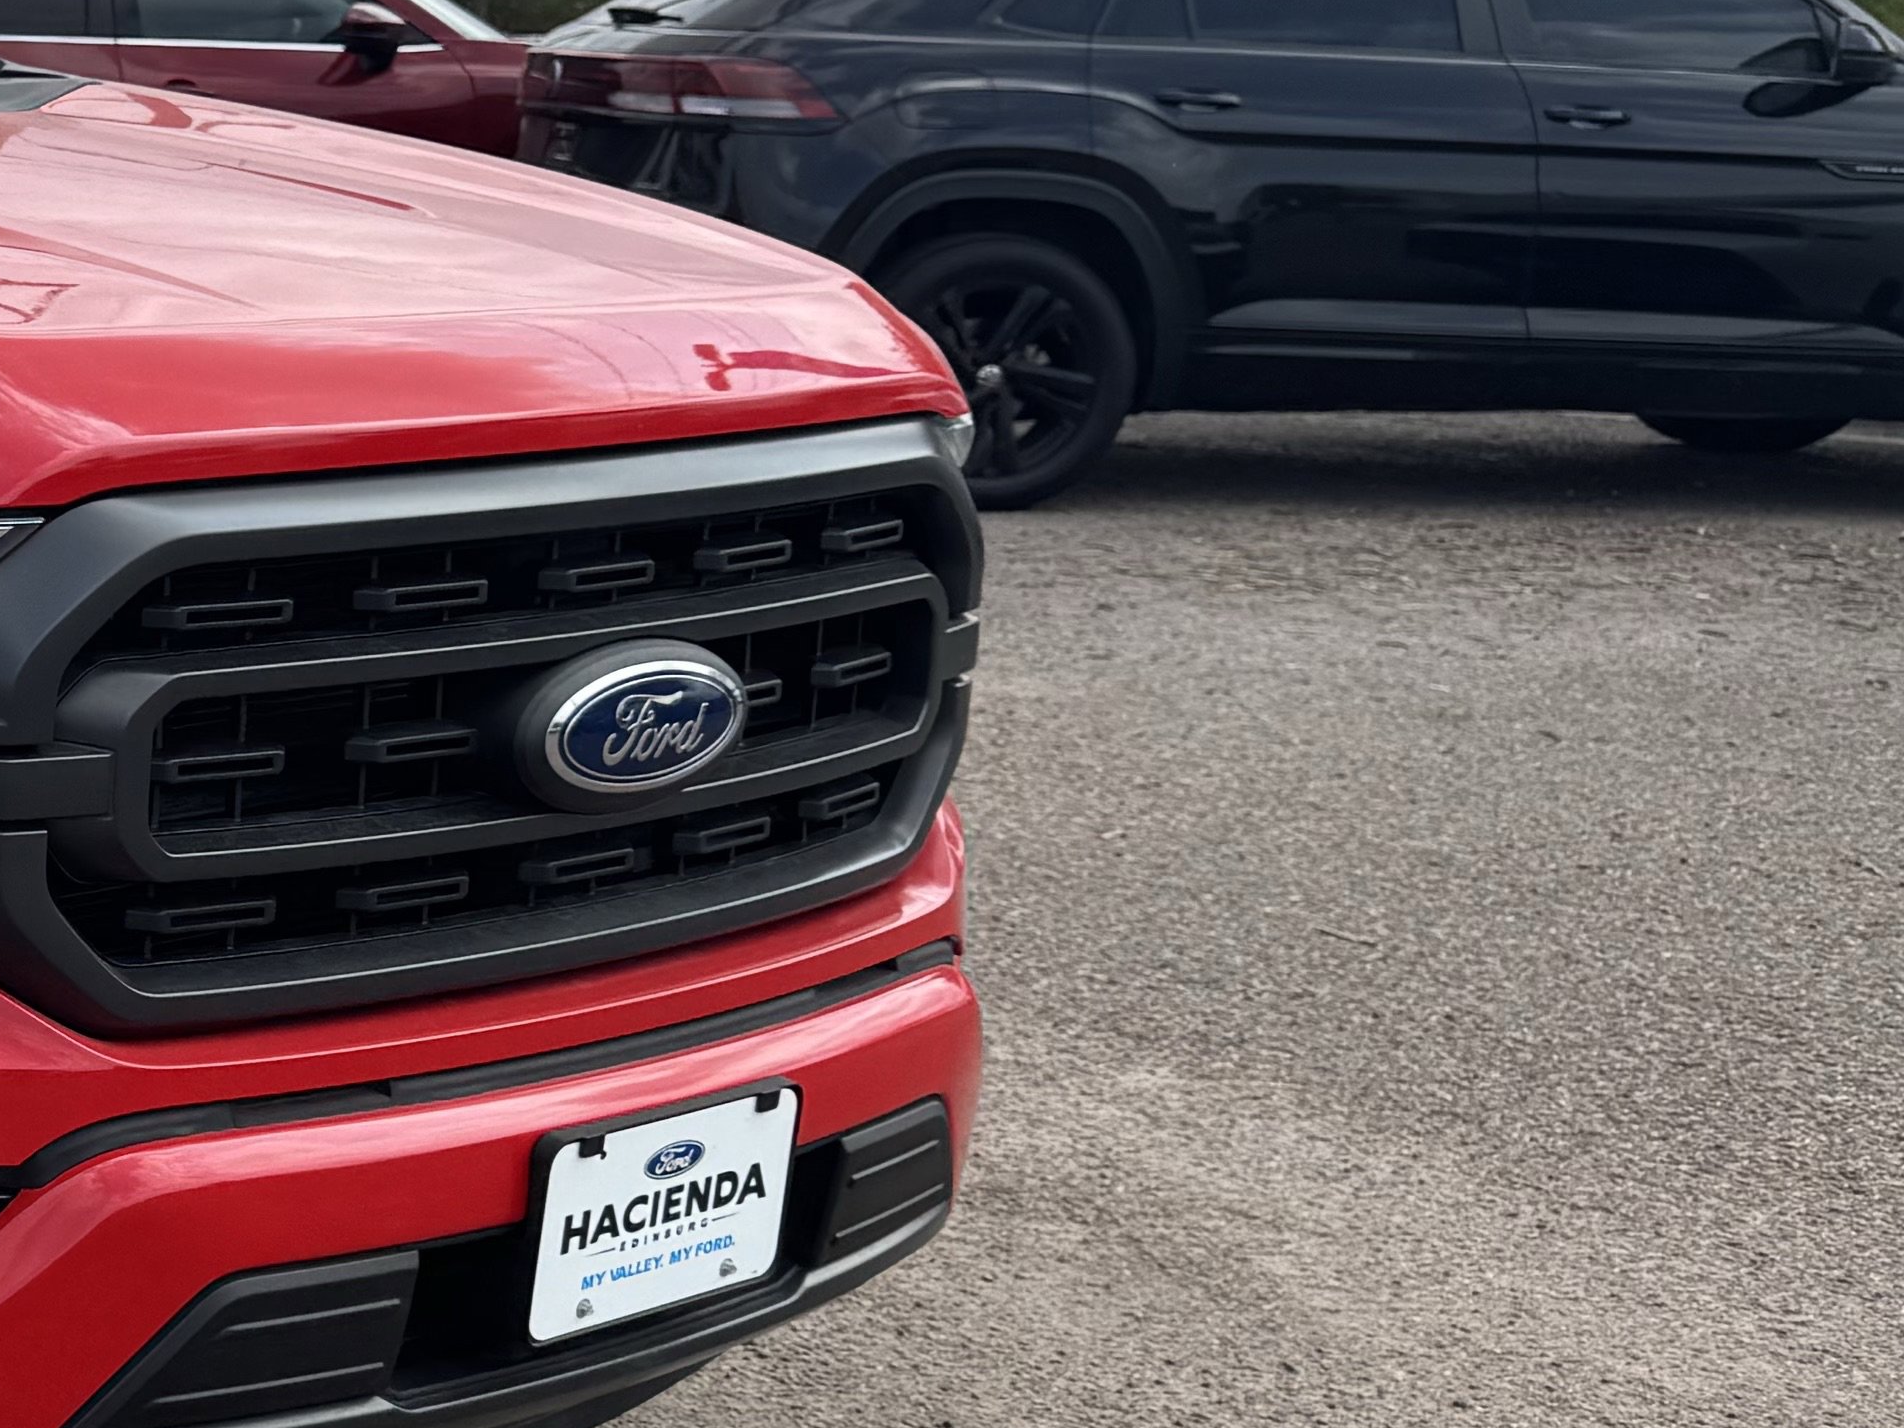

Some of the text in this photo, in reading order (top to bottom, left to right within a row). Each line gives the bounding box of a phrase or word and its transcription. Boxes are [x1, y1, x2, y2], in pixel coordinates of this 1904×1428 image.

[602, 690, 710, 766] Ford
[560, 1162, 766, 1255] HACIENDA
[619, 1217, 709, 1253] EDINBURG
[580, 1234, 735, 1291] MY VALLEY. MY FORD.
